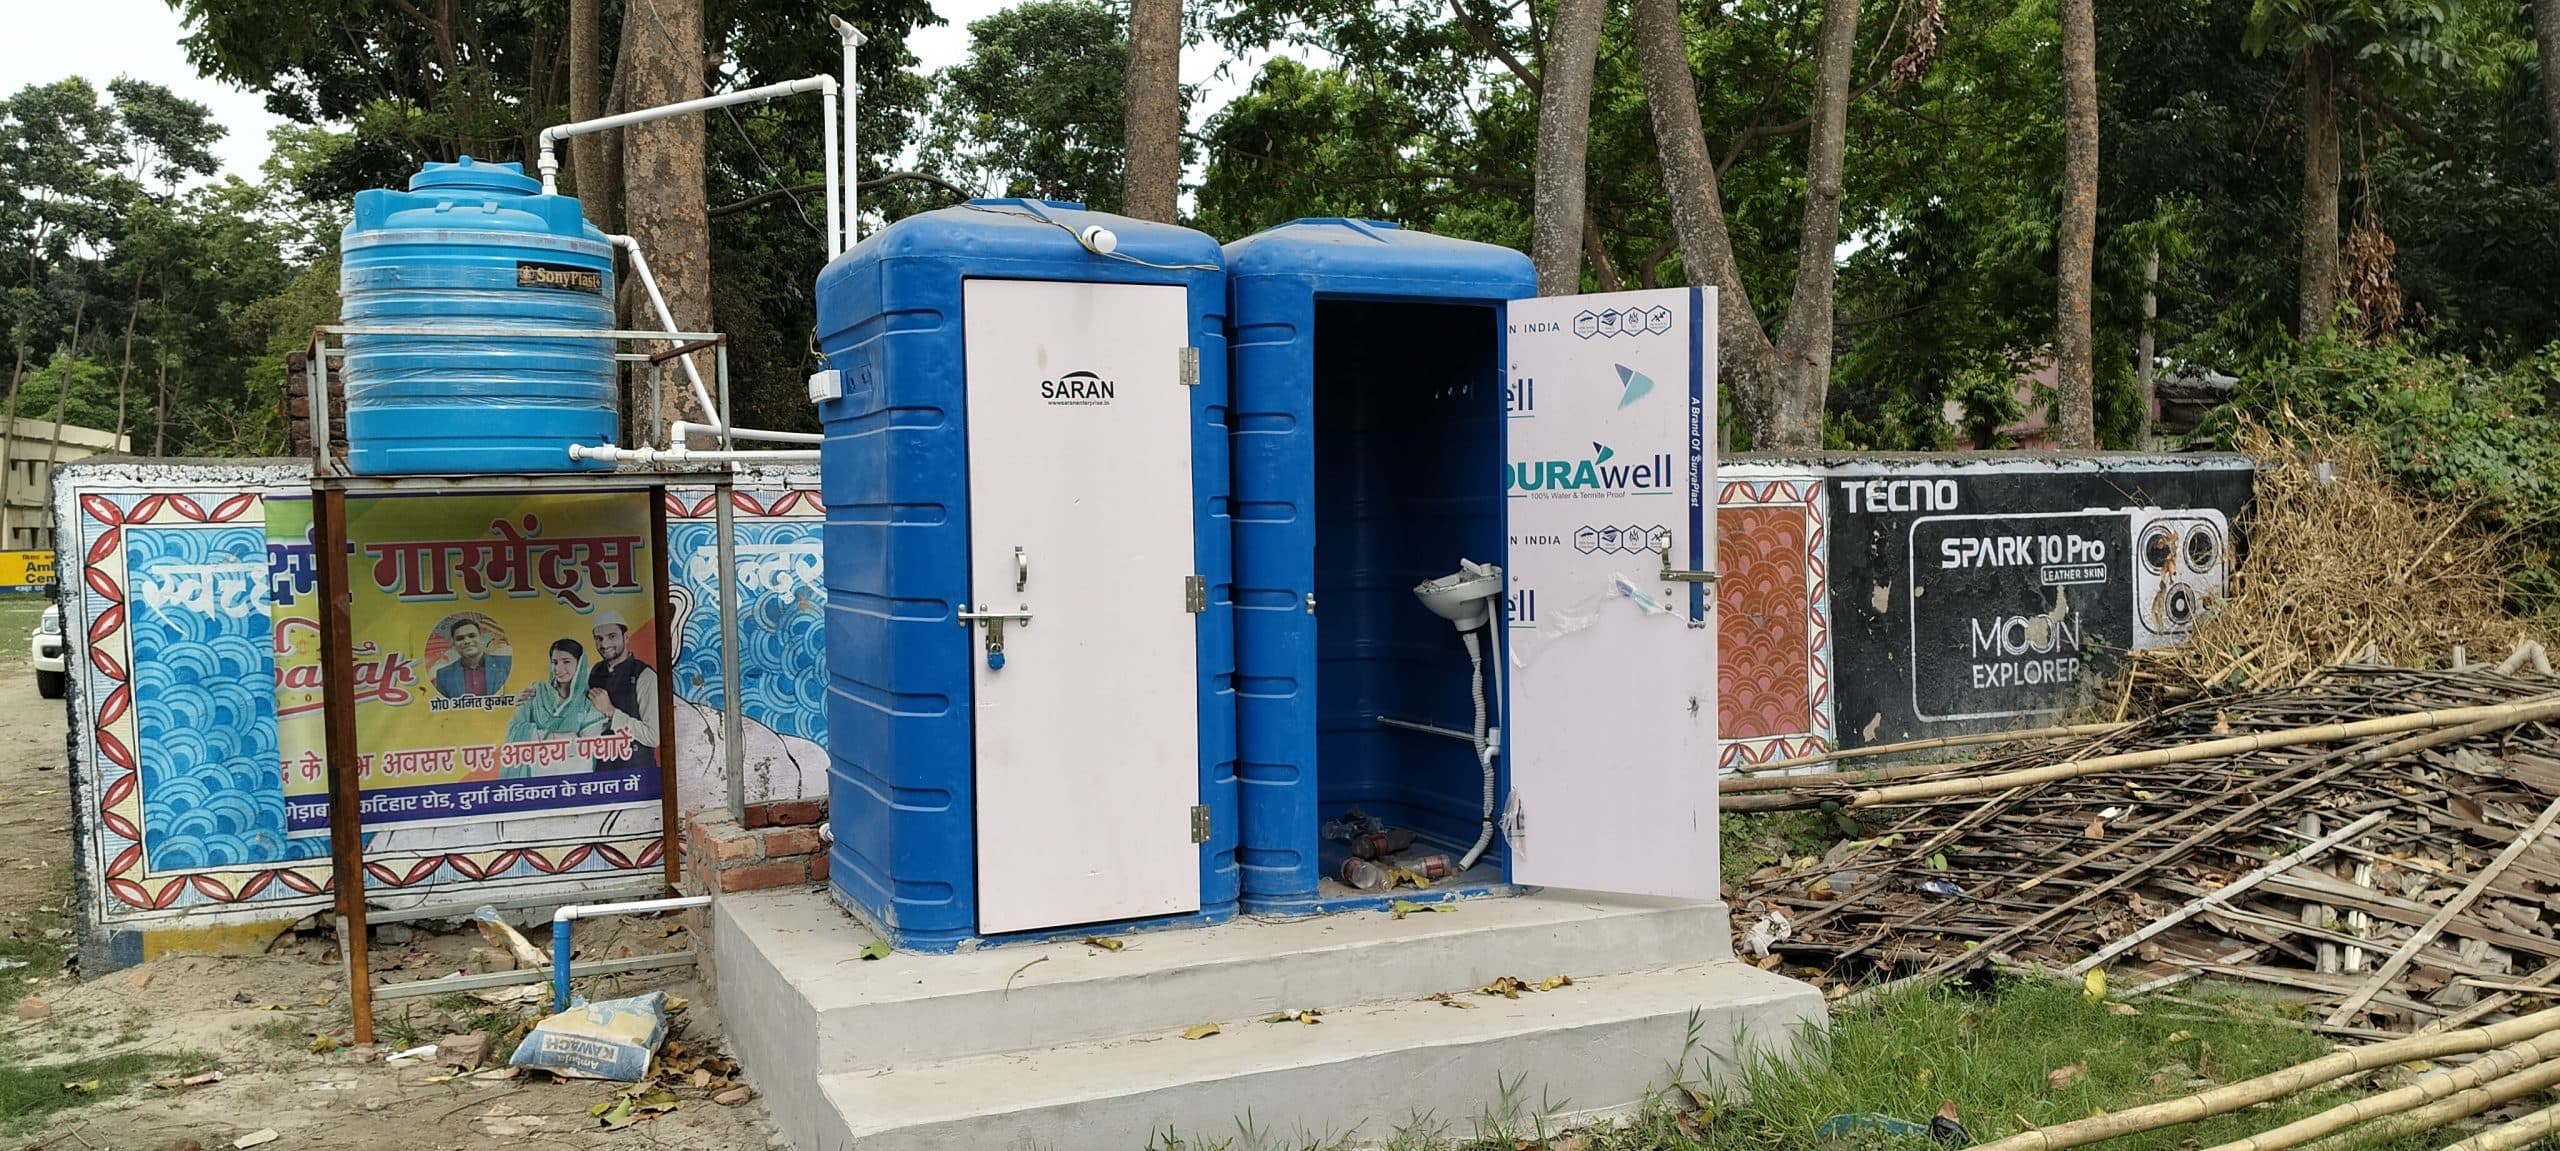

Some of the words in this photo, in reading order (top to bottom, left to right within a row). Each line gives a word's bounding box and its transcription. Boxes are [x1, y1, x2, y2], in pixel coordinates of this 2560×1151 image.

[1524, 322, 1560, 333] INDIA
[1041, 380, 1114, 399] SARAN
[1690, 396, 1700, 405] A
[1691, 407, 1701, 436] Brand
[1691, 438, 1700, 451] Of
[1531, 492, 1549, 500] 100%
[1551, 491, 1571, 499] Water
[1573, 491, 1578, 499] &
[1580, 490, 1604, 499] Termite
[1606, 490, 1626, 498] Proof
[1840, 479, 1959, 514] TECNO
[1525, 535, 1561, 545] INDIA
[1941, 536, 2034, 569] SPARK
[2038, 535, 2063, 564] 10
[2067, 534, 2106, 563] Pro
[365, 513, 641, 609] गारमेंट्स
[2043, 569, 2081, 582] LEATHER
[2084, 567, 2104, 578] SKIN
[1971, 611, 2080, 659] MOON
[1972, 657, 2080, 689] EXPLORER
[452, 695, 482, 709] अमित
[300, 751, 323, 781] के
[383, 748, 455, 775] अवसर
[463, 746, 494, 769] पर
[502, 740, 570, 767] अवश्य
[577, 726, 633, 760] पधारें
[420, 790, 455, 810] रोड,
[458, 786, 489, 810] दुर्गा
[493, 783, 558, 802] मेडिकल
[560, 780, 577, 797] के
[580, 778, 621, 796] बगल
[623, 774, 642, 791] में
